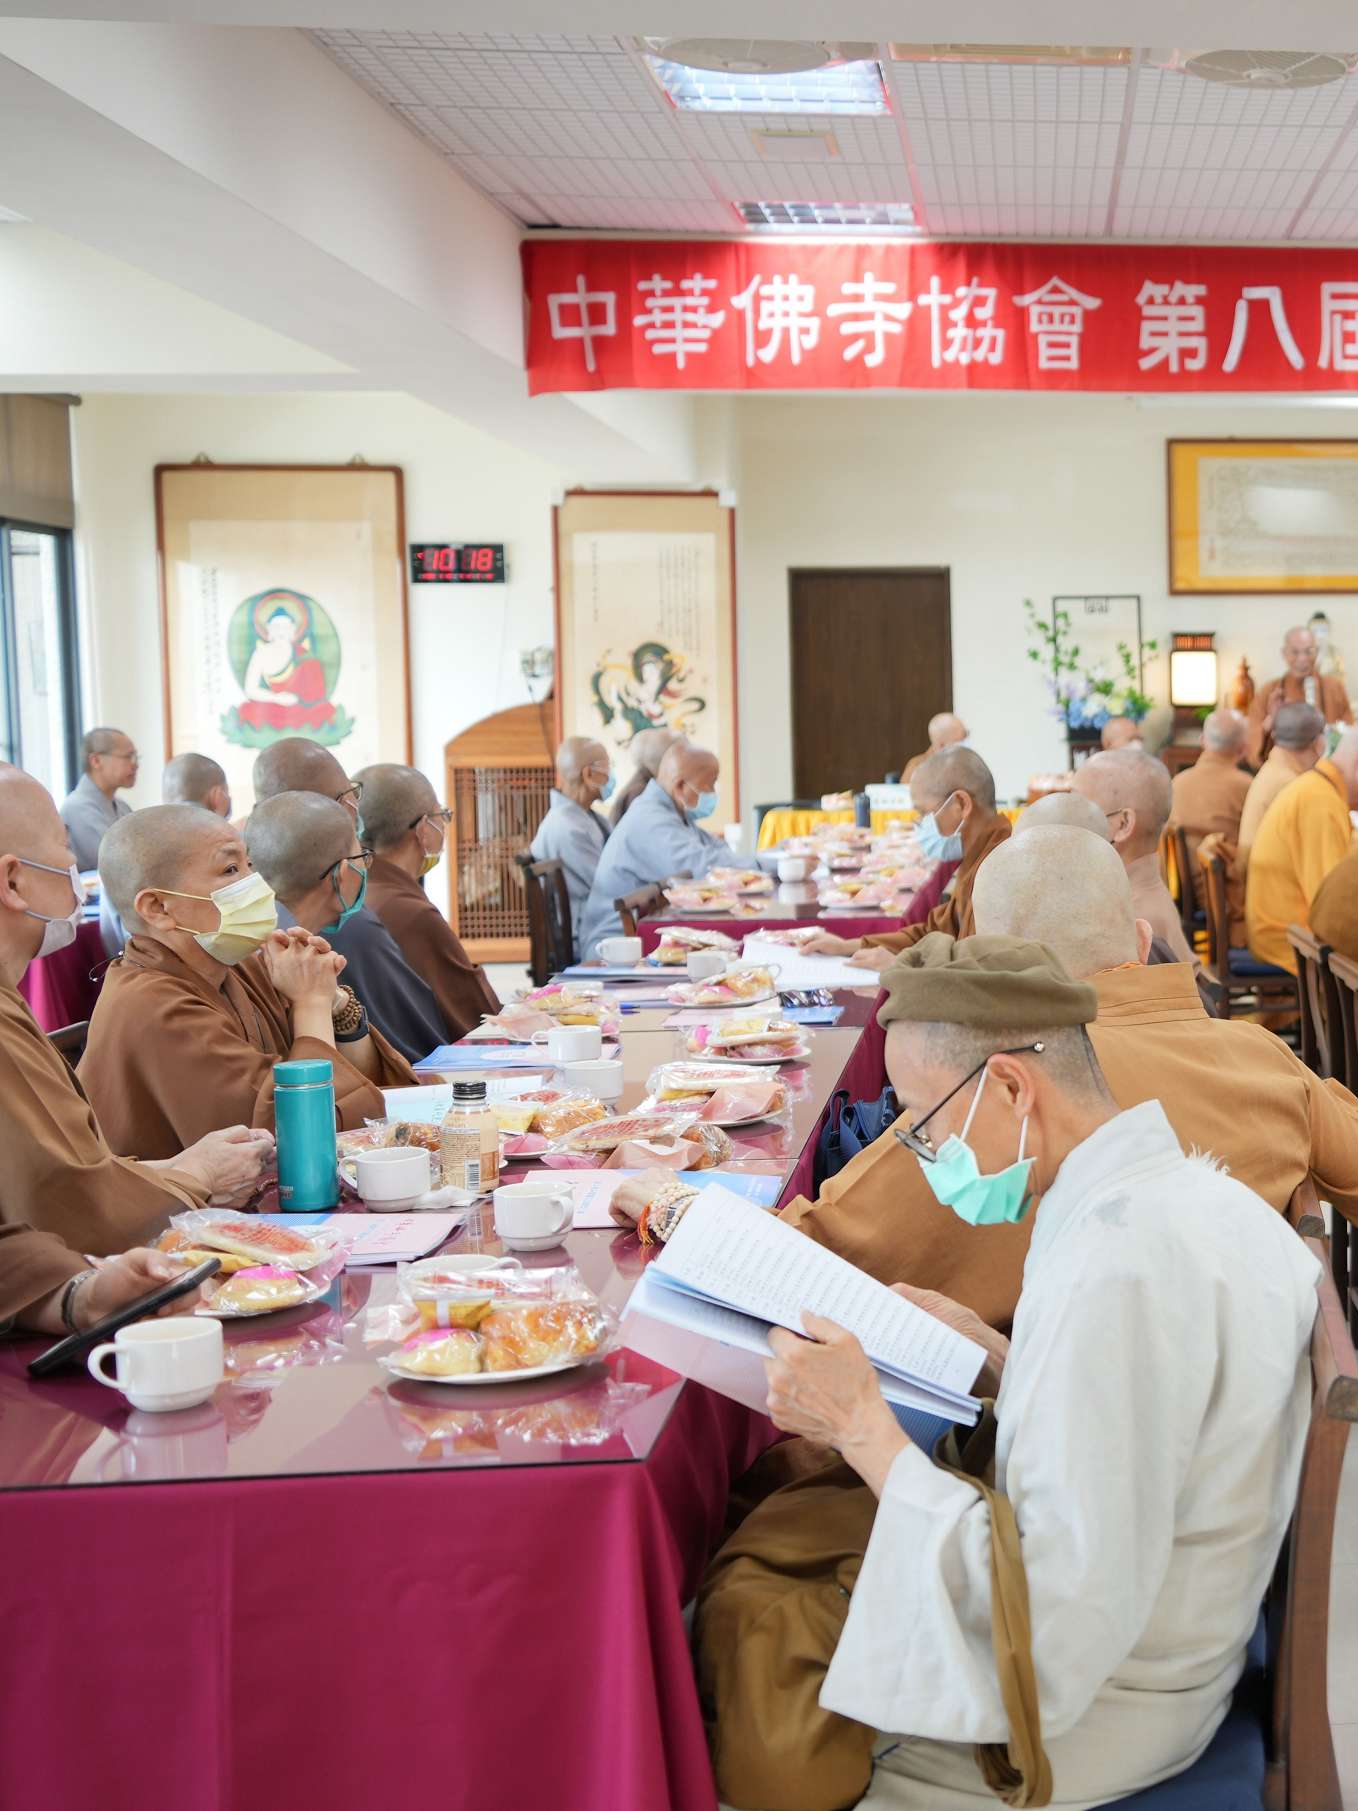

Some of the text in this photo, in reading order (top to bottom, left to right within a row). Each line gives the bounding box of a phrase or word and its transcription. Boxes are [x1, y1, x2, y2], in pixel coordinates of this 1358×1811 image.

[548, 272, 1102, 373] 中華佛寺協會
